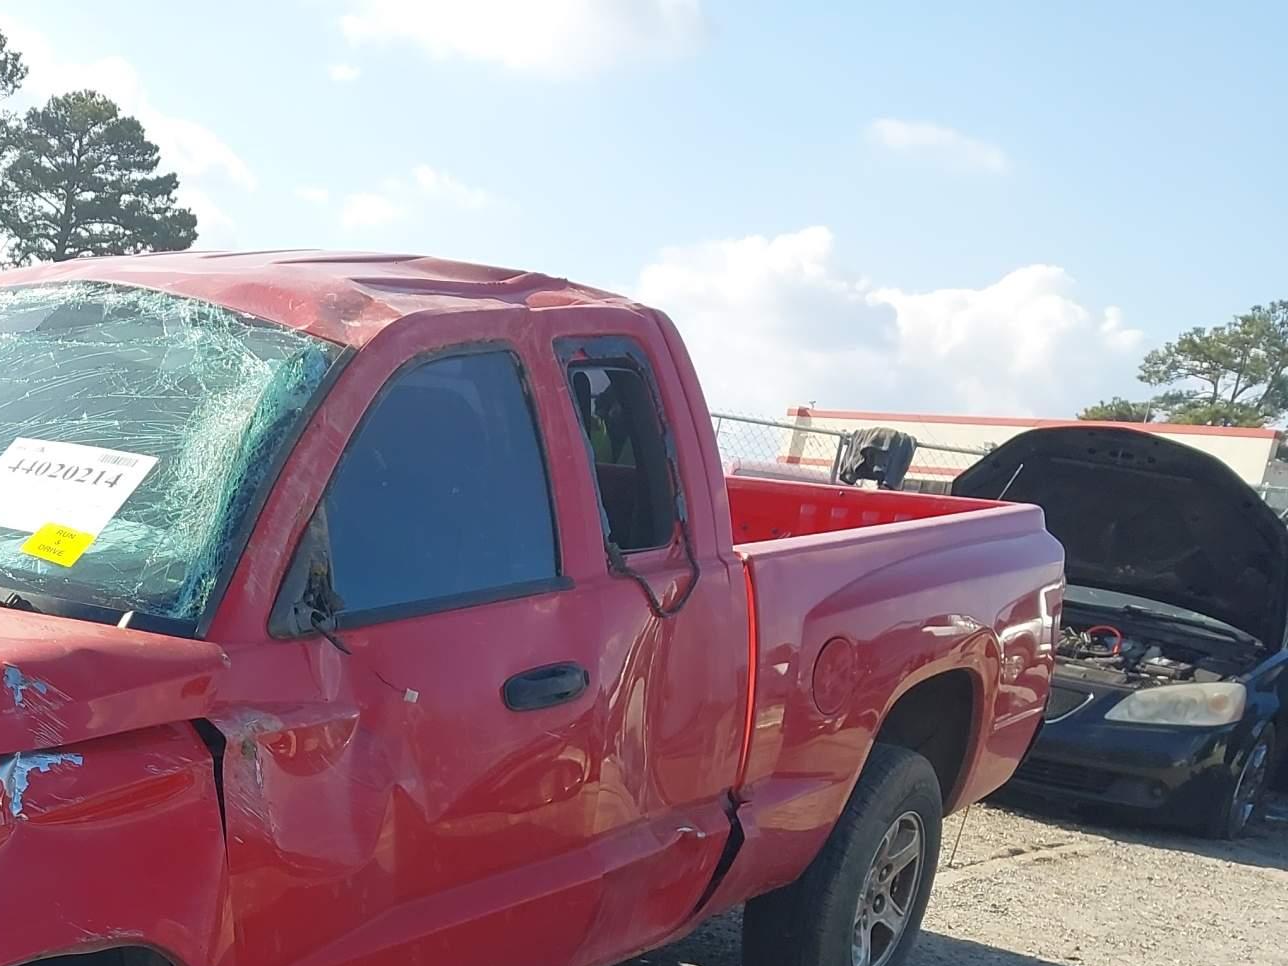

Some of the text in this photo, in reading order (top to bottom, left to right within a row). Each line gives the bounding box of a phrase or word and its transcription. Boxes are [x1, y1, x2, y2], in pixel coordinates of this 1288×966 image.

[8, 458, 124, 488] 44020214
[56, 529, 77, 540] RUN
[37, 543, 65, 557] DRIVE
